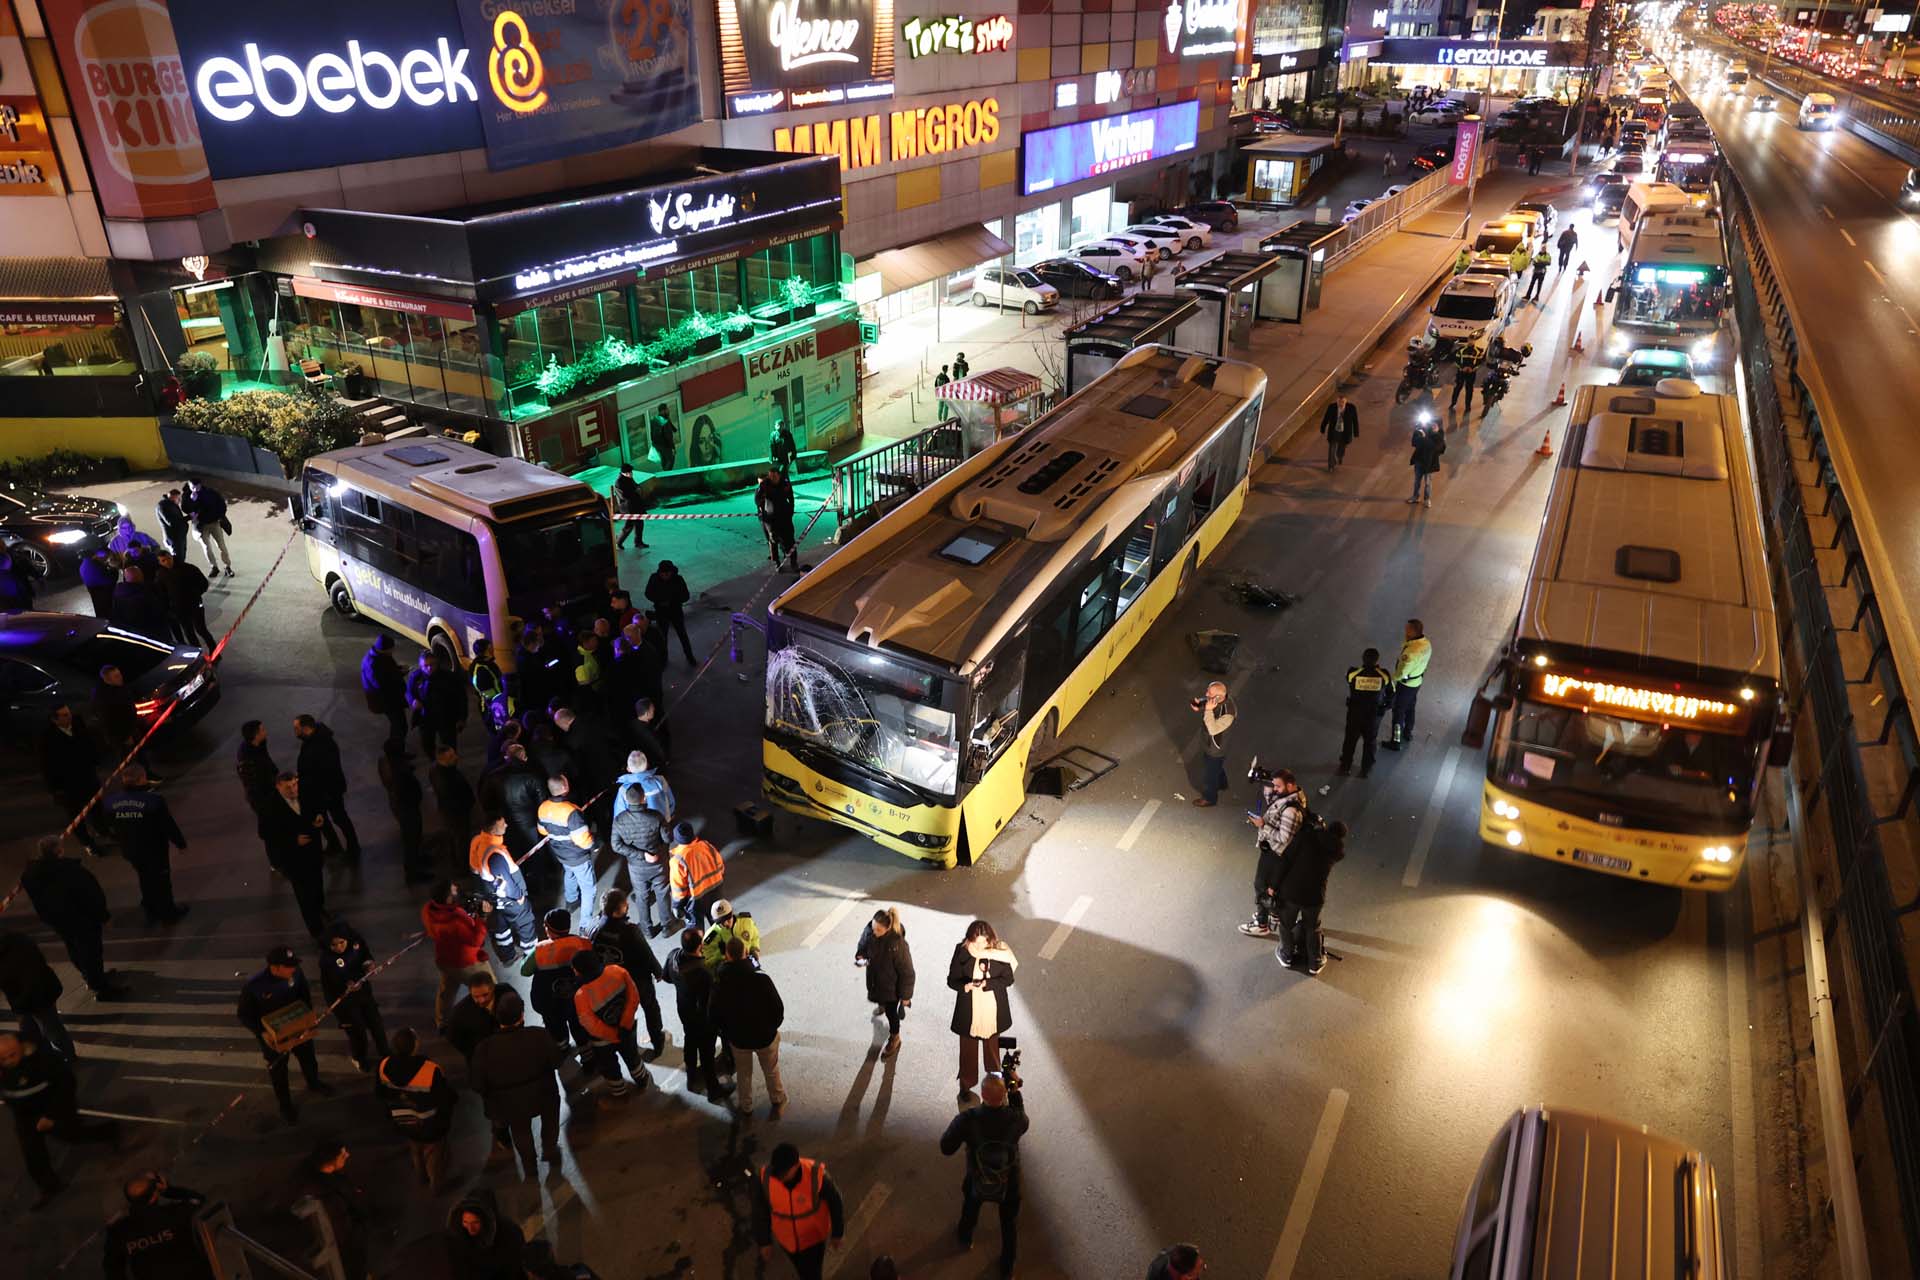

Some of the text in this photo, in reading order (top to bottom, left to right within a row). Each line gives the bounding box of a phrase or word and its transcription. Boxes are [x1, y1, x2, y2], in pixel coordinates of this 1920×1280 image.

[976, 15, 1013, 53] SHOP
[1454, 48, 1547, 65] enza HOME
[86, 61, 188, 97] BURGE
[197, 37, 478, 121] ebebek
[774, 115, 881, 171] MMM
[1091, 115, 1154, 163] Vatan
[1095, 152, 1149, 174] COMPUTER
[35, 314, 96, 322] RESTAURANT
[865, 327, 874, 340] E
[749, 336, 815, 379] ECZANE
[777, 369, 791, 380] HAS
[524, 426, 536, 465] ECZAN
[578, 411, 600, 448] E
[354, 565, 382, 590] getir
[383, 581, 392, 597] bi
[393, 588, 432, 617] mutluluk
